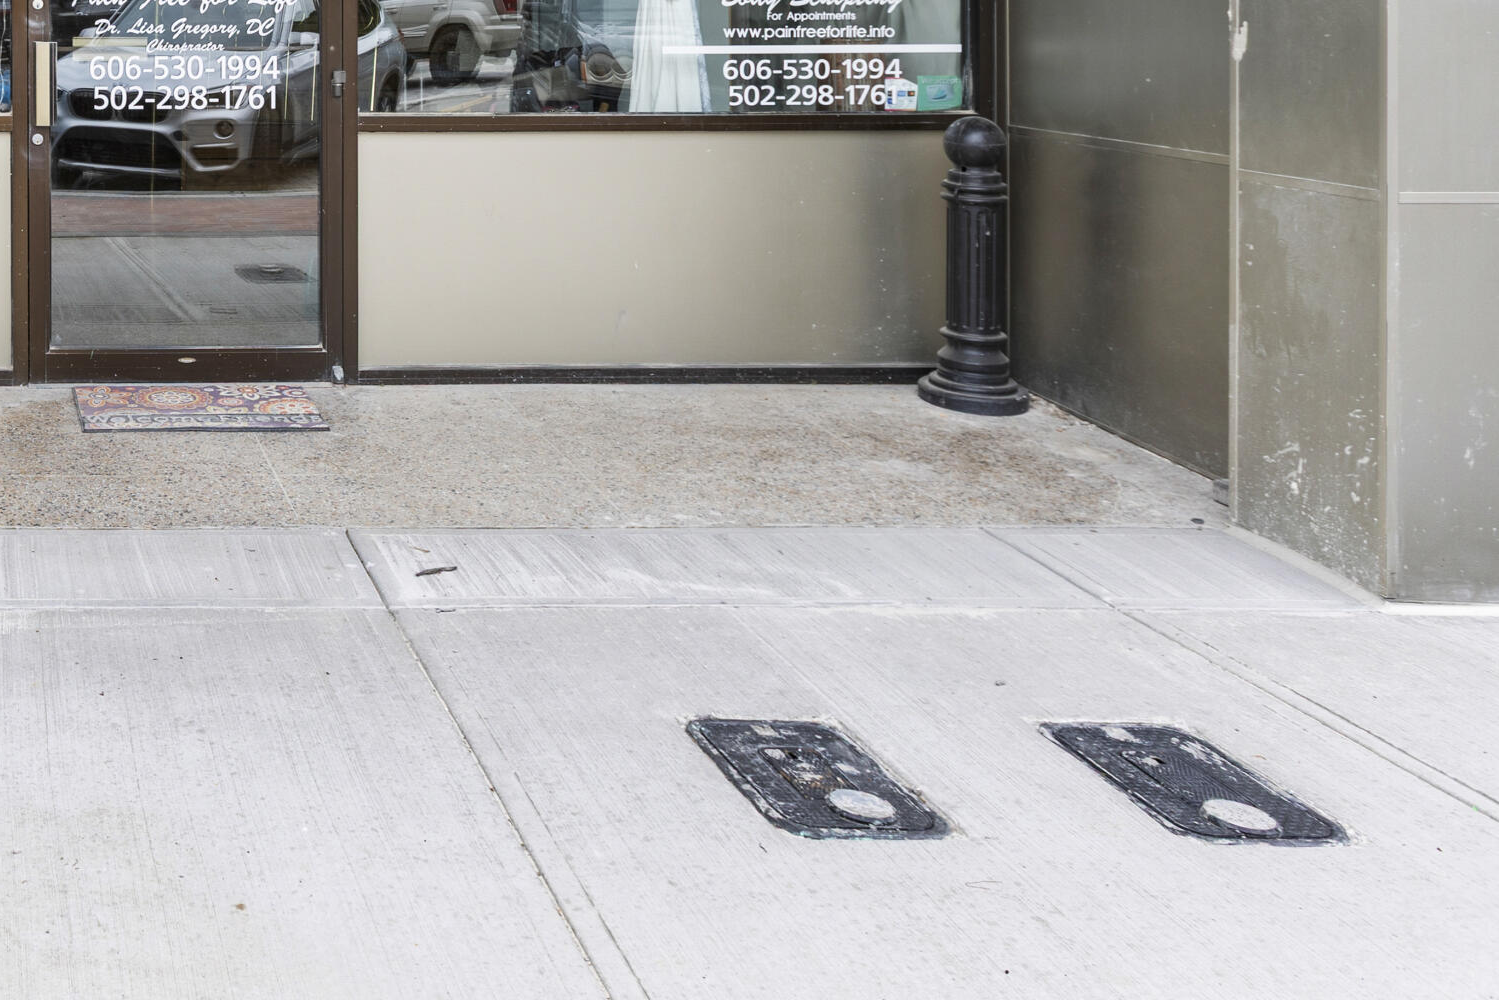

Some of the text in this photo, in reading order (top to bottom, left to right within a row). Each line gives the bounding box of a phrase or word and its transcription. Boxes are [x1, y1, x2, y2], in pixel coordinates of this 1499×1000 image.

[766, 10, 856, 22] For Appointments
[94, 18, 121, 36] Dr.
[126, 17, 165, 35] Lisa
[245, 17, 275, 37] DC
[723, 25, 895, 40] www.painfreeforlife.info
[146, 40, 225, 54] Chiropractor
[89, 55, 281, 81] 606-530-1994
[722, 59, 902, 80] 606-530-1994
[93, 85, 277, 111] 502-298-1761
[729, 85, 899, 107] 502-298-1761
